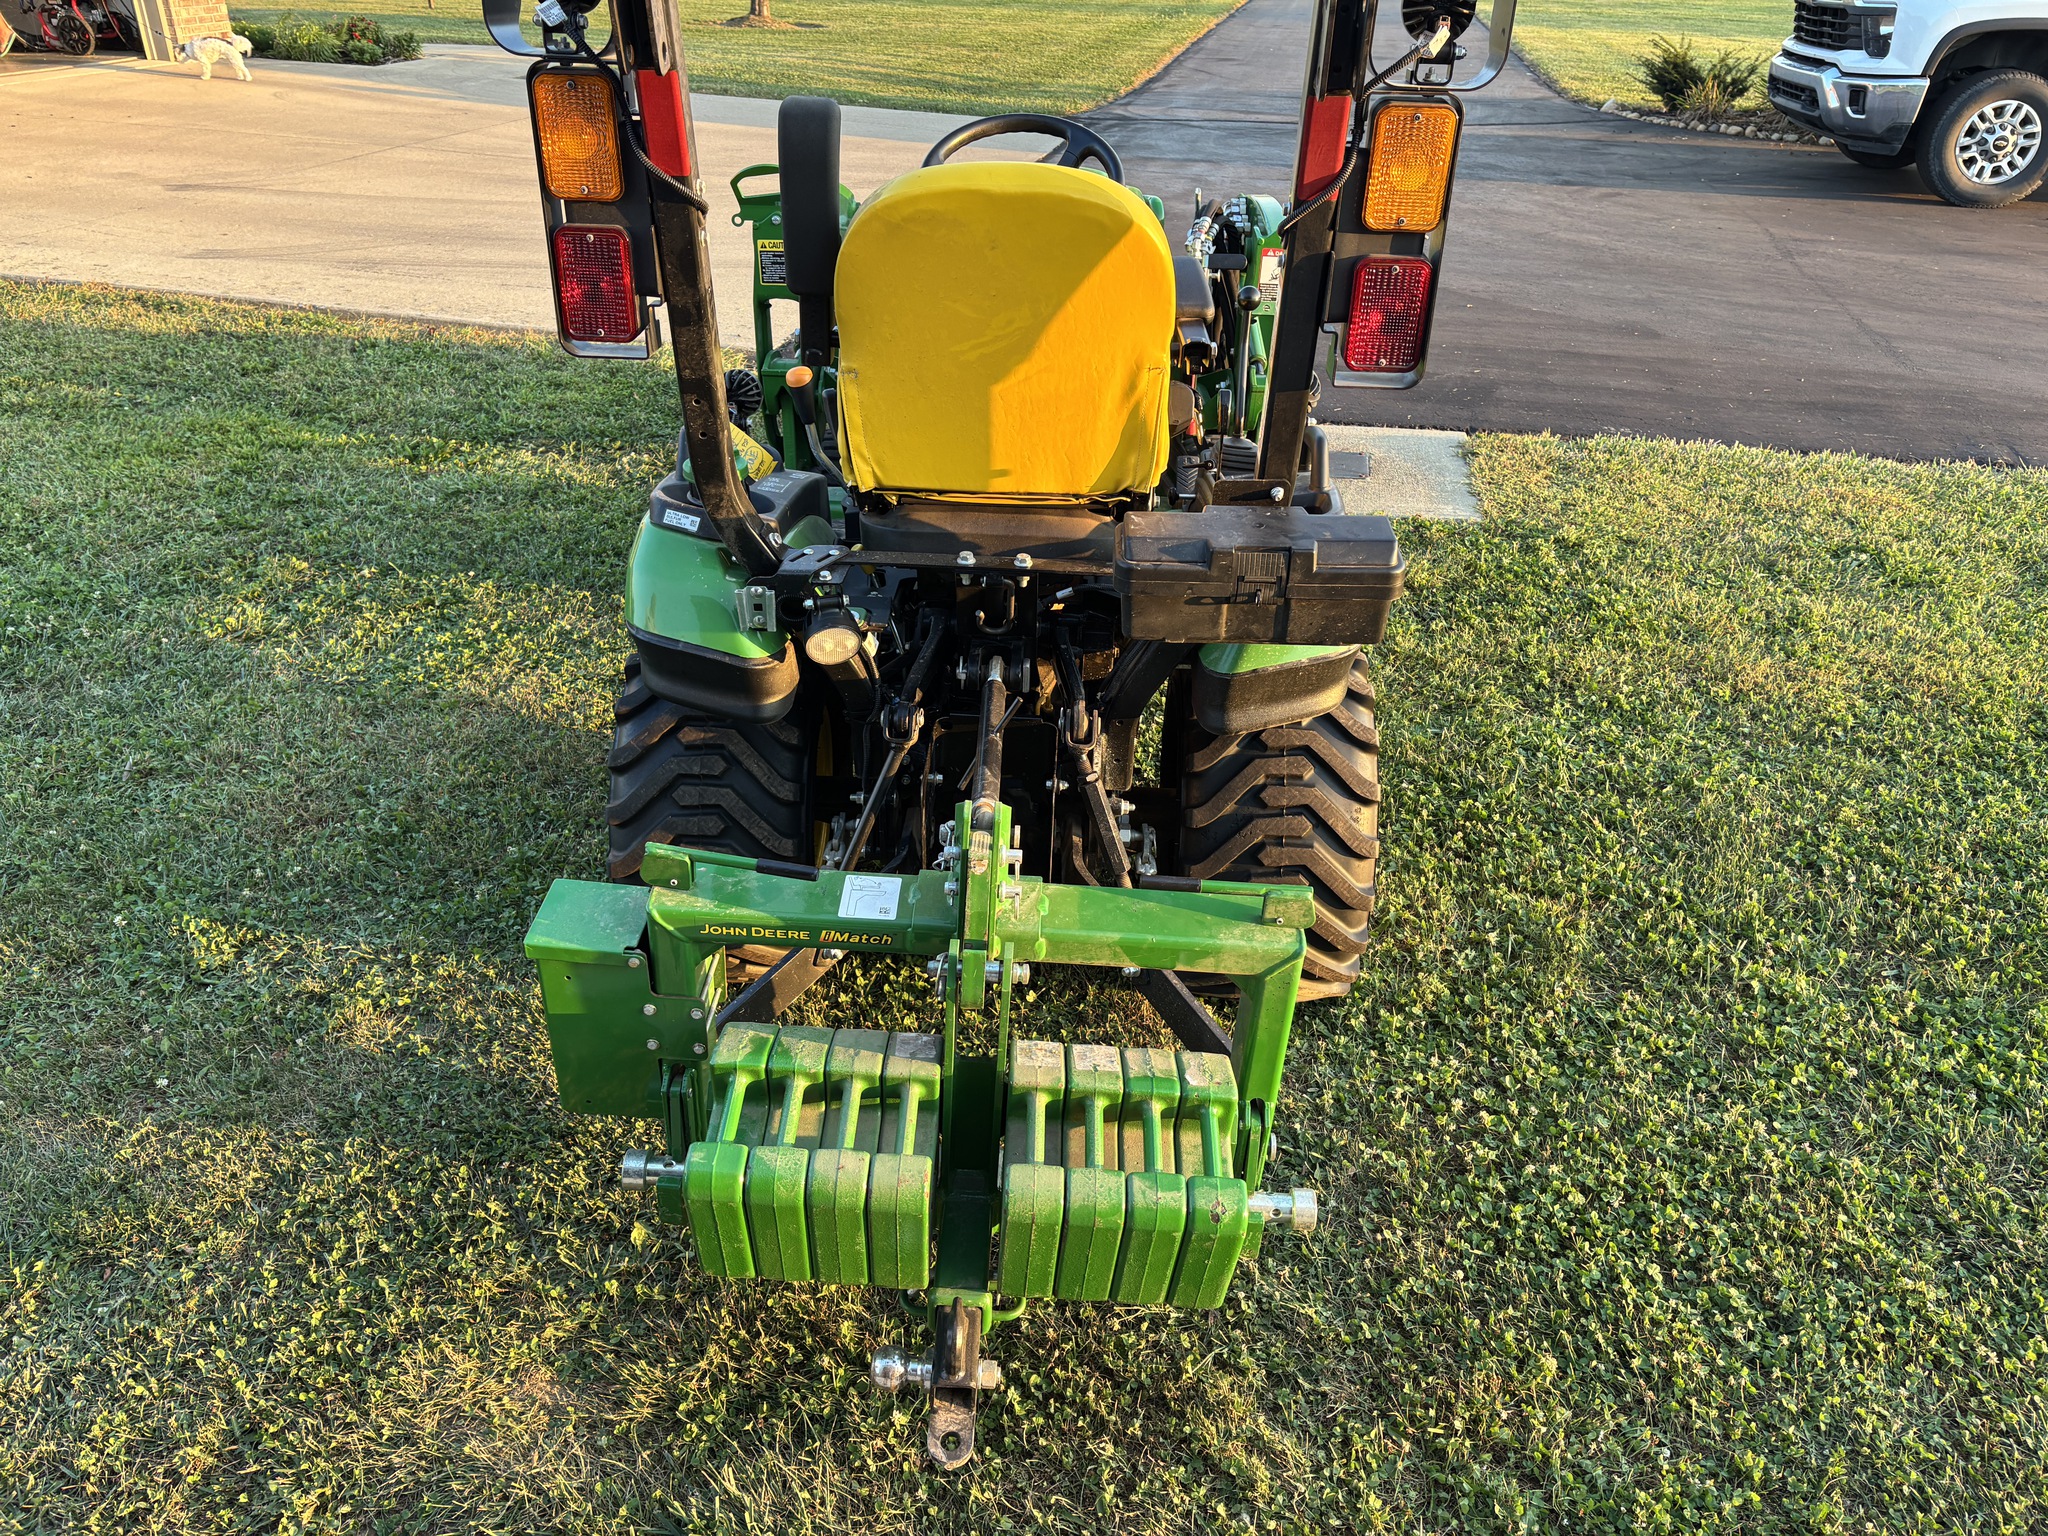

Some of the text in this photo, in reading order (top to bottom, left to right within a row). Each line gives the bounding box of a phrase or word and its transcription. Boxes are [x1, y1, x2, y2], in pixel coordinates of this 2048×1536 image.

[767, 241, 784, 249] CAUT
[700, 924, 893, 945] JOHN DEERE iMatch
